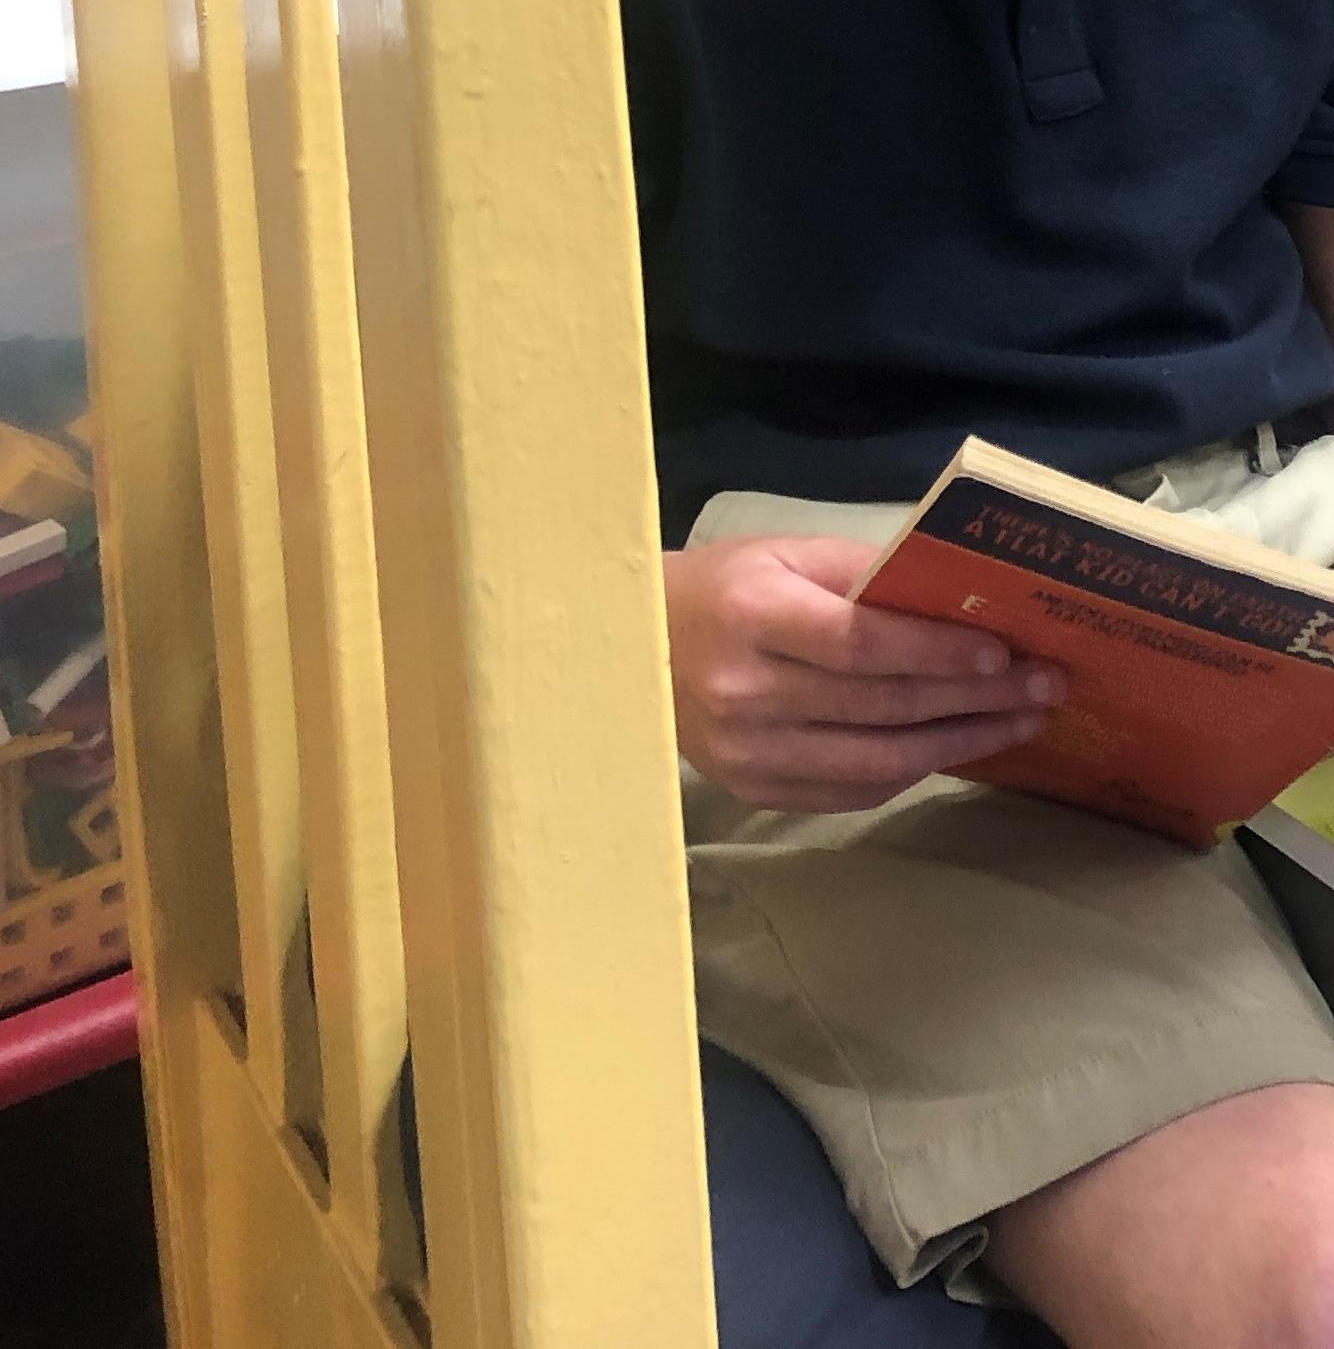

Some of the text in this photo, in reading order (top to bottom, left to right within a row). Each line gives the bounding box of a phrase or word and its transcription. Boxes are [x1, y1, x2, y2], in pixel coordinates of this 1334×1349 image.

[962, 519, 985, 539] A
[993, 527, 1066, 564] FLAT
[1075, 555, 1136, 588] KID
